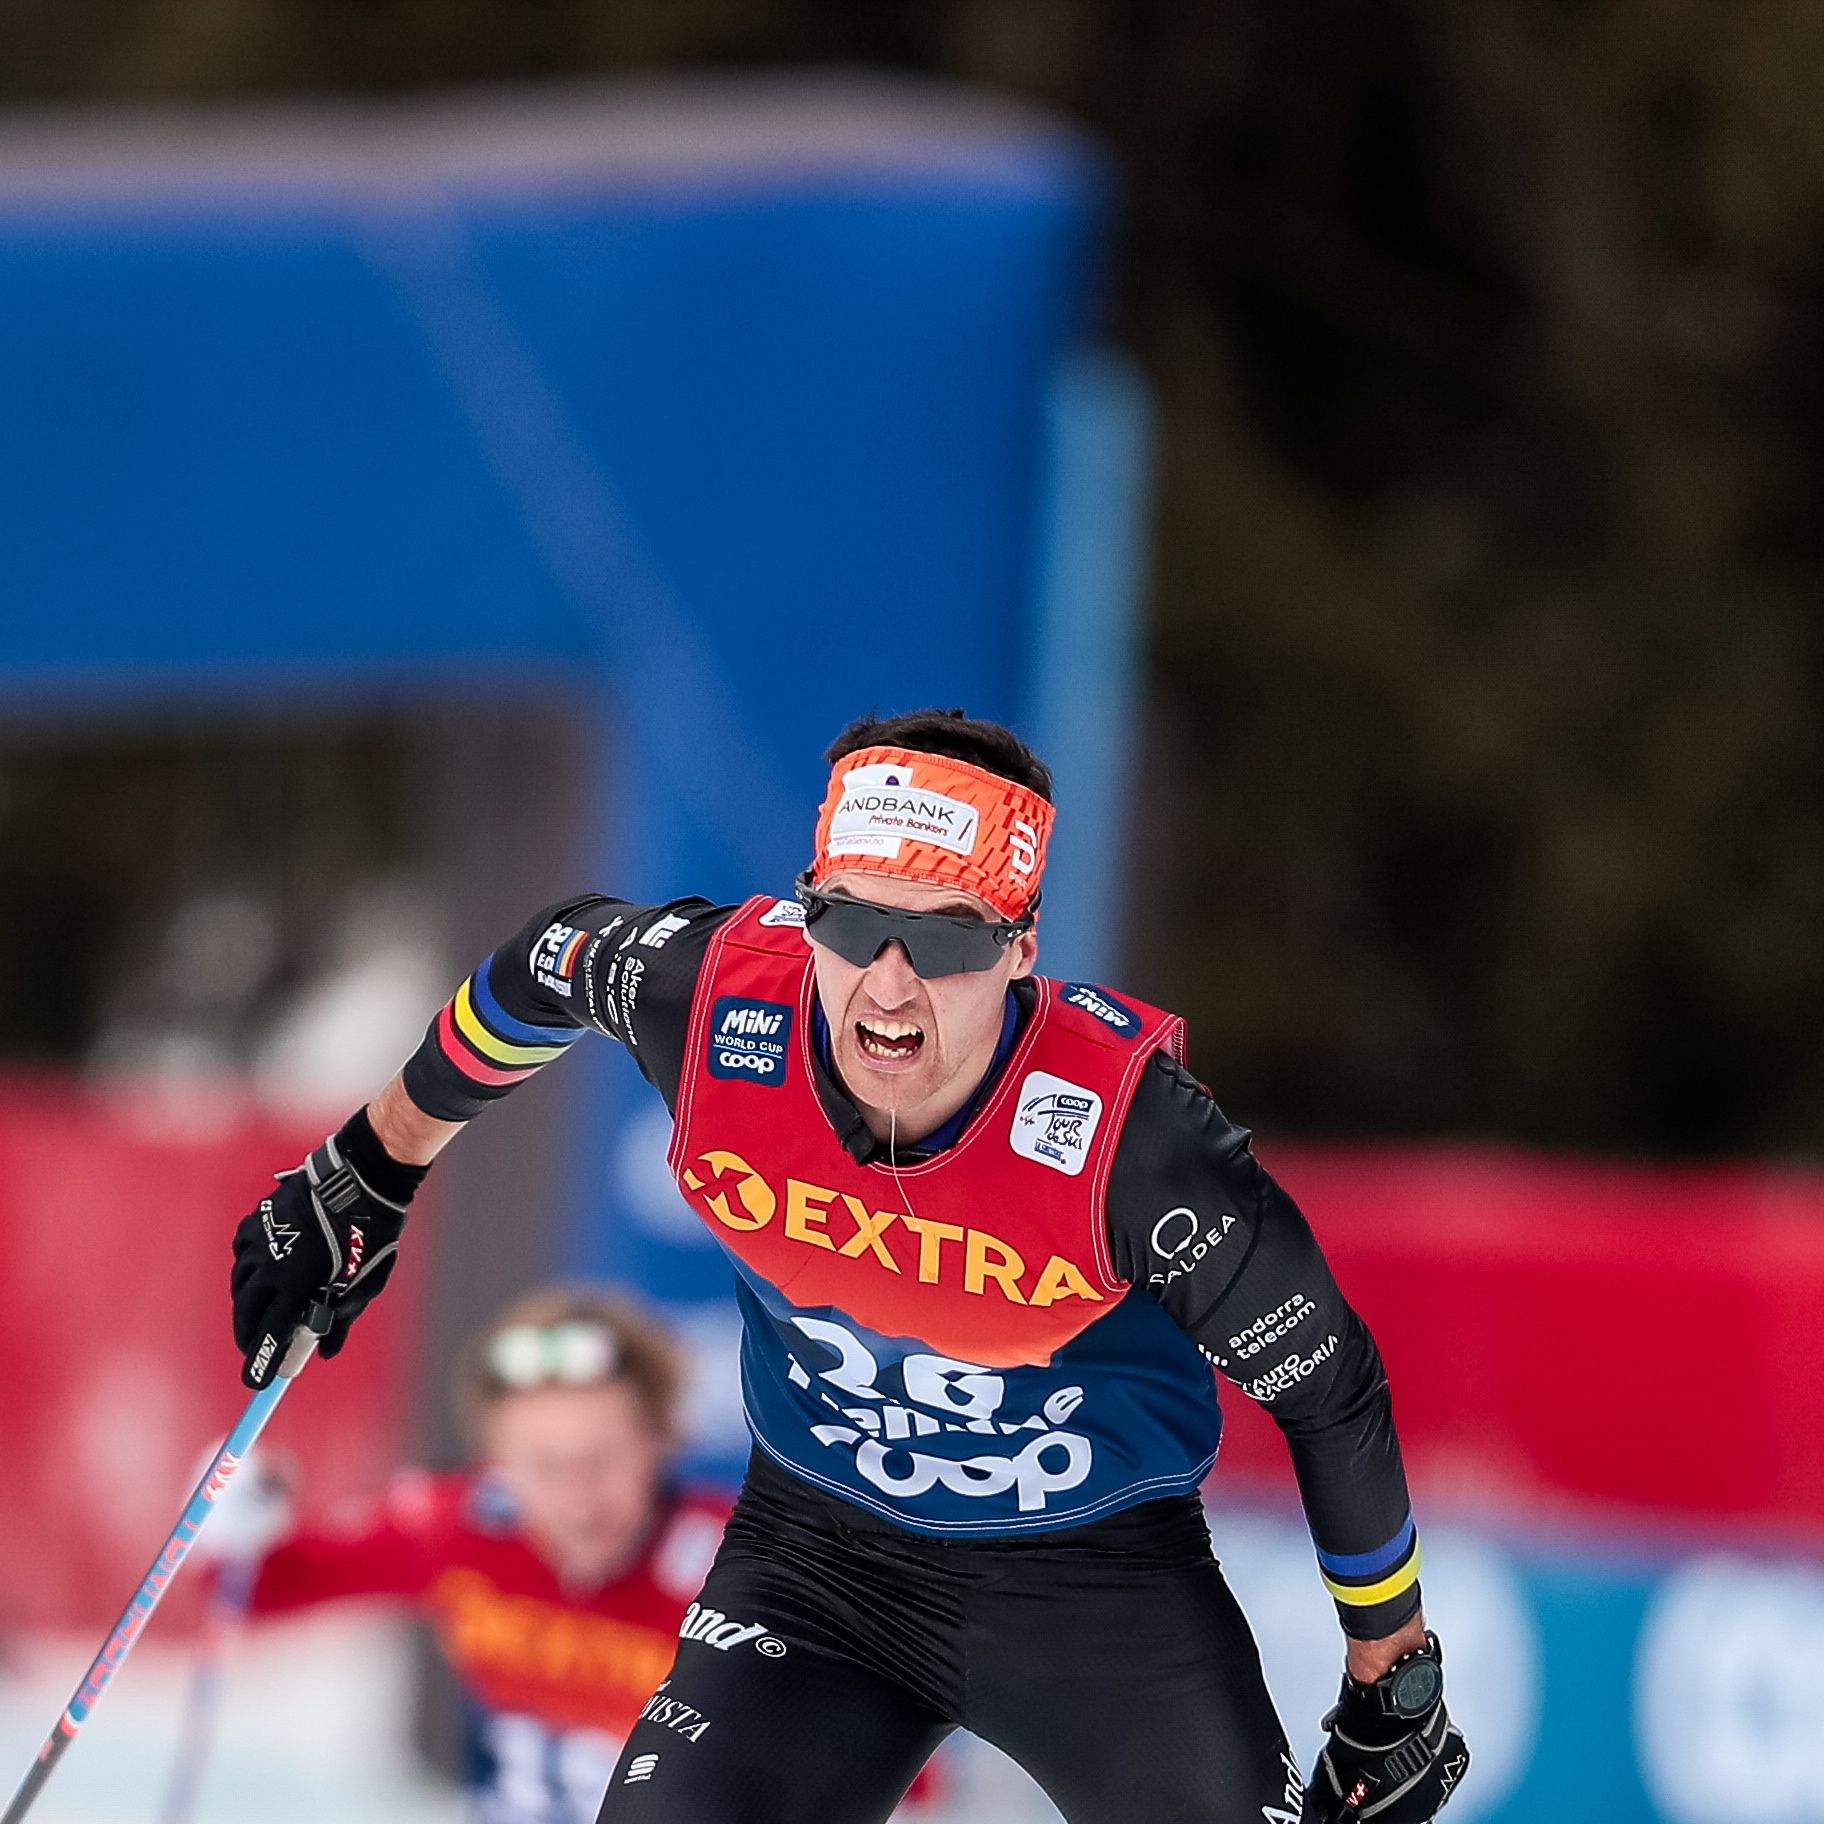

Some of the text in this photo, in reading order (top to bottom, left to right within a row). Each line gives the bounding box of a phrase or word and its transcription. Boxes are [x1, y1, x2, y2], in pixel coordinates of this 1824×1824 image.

[838, 797, 956, 826] ANDBANK
[714, 1034, 783, 1053] WORLD CUP
[719, 1052, 775, 1074] coop
[1061, 1097, 1089, 1110] coop
[784, 1178, 1104, 1307] EXTRA
[1228, 1293, 1305, 1349] andorra
[1236, 1301, 1316, 1360] telecom
